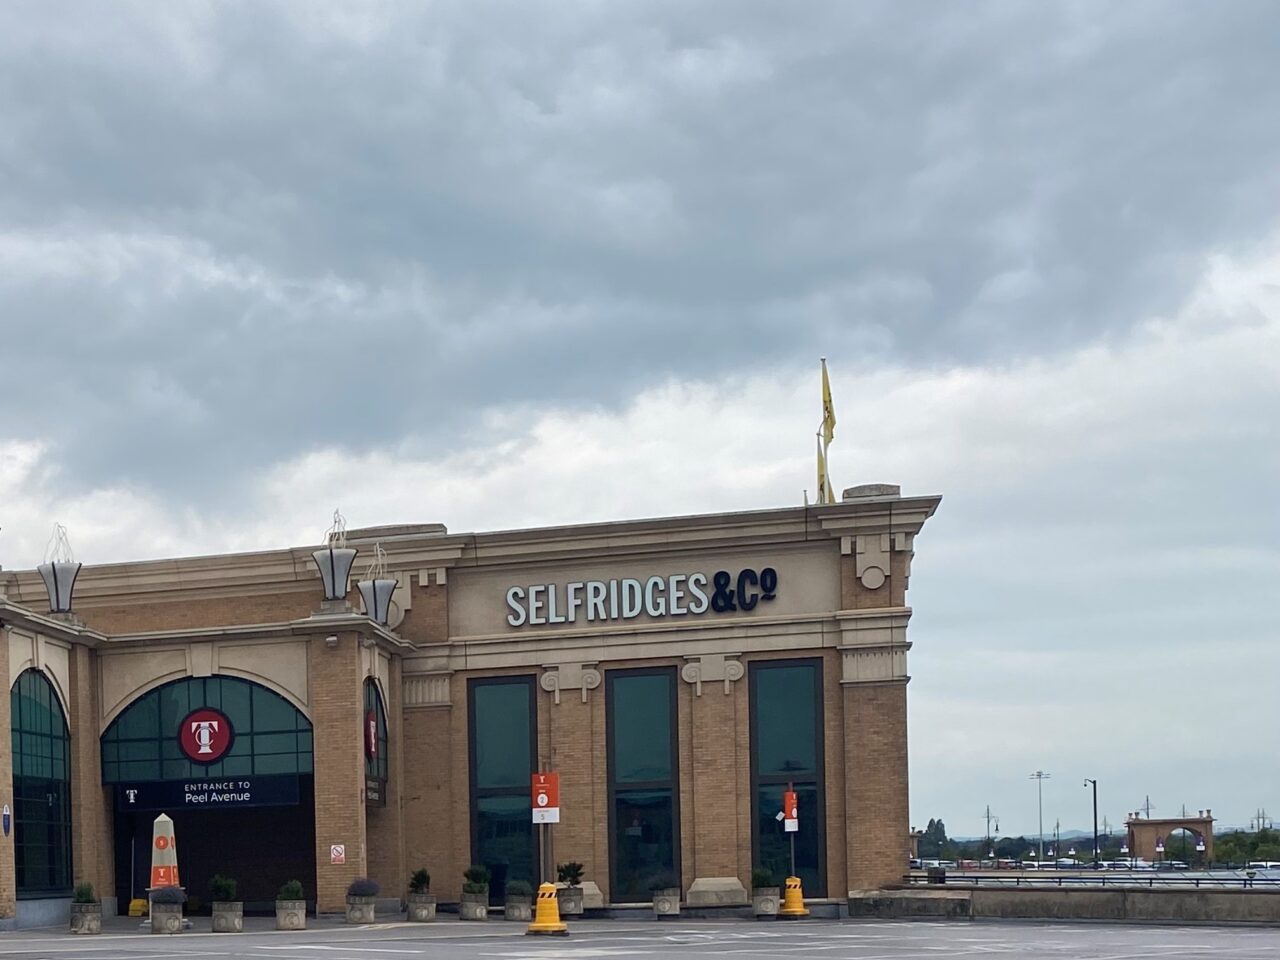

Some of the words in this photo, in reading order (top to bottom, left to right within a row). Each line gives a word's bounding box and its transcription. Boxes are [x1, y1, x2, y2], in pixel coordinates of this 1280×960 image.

[184, 782, 235, 792] ENTRANCE
[238, 781, 250, 789] TO
[185, 792, 208, 803] Peel
[210, 792, 250, 802] Avenue
